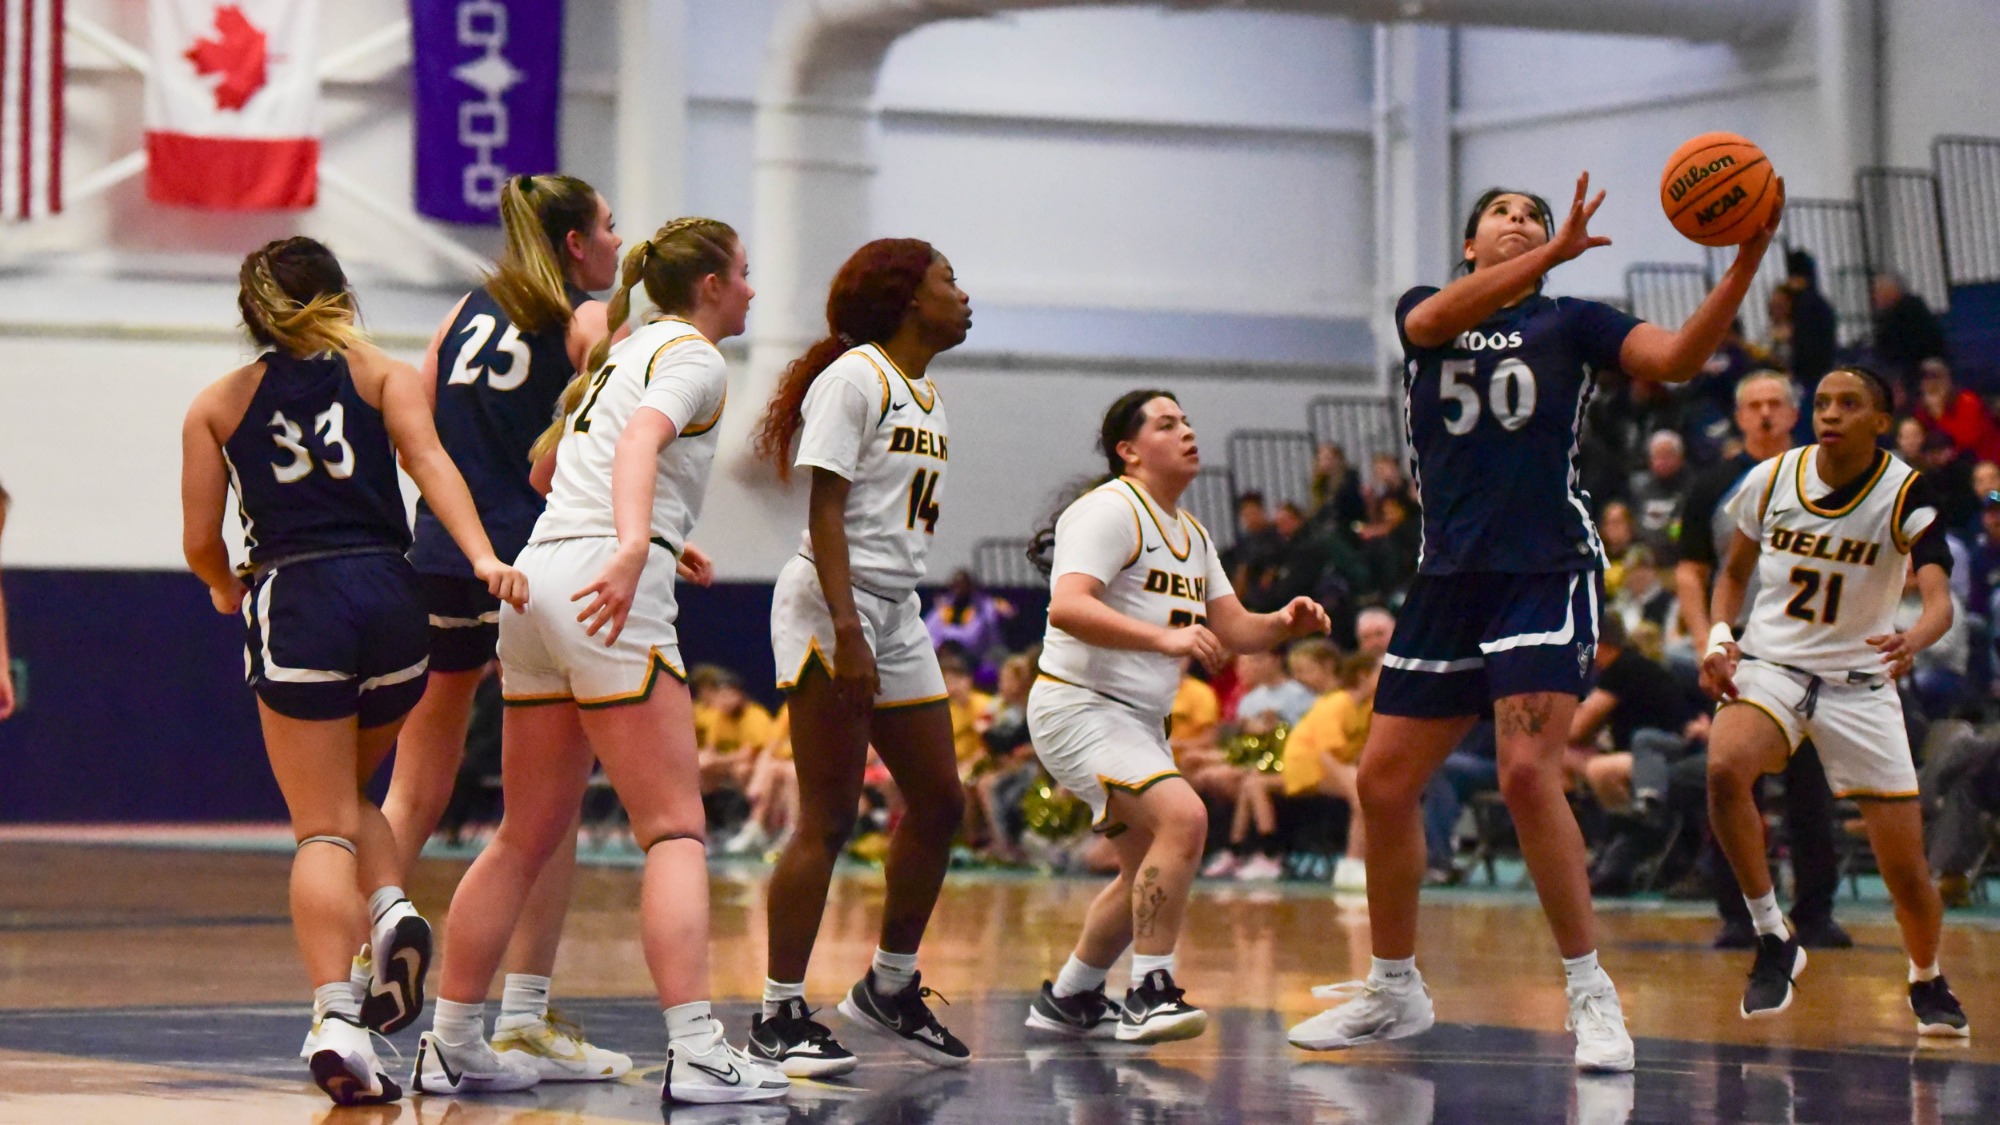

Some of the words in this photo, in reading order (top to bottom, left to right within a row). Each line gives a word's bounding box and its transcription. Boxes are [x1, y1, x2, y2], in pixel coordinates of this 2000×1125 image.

[1667, 154, 1736, 203] Wilson
[1695, 184, 1748, 226] NCAA
[447, 313, 532, 391] 25
[573, 364, 618, 435] 2
[1439, 357, 1537, 436] 50
[267, 401, 355, 484] 33
[906, 467, 940, 535] 14
[1770, 527, 1881, 566] DELHI
[1142, 567, 1206, 603] DELH
[1785, 566, 1844, 624] 21
